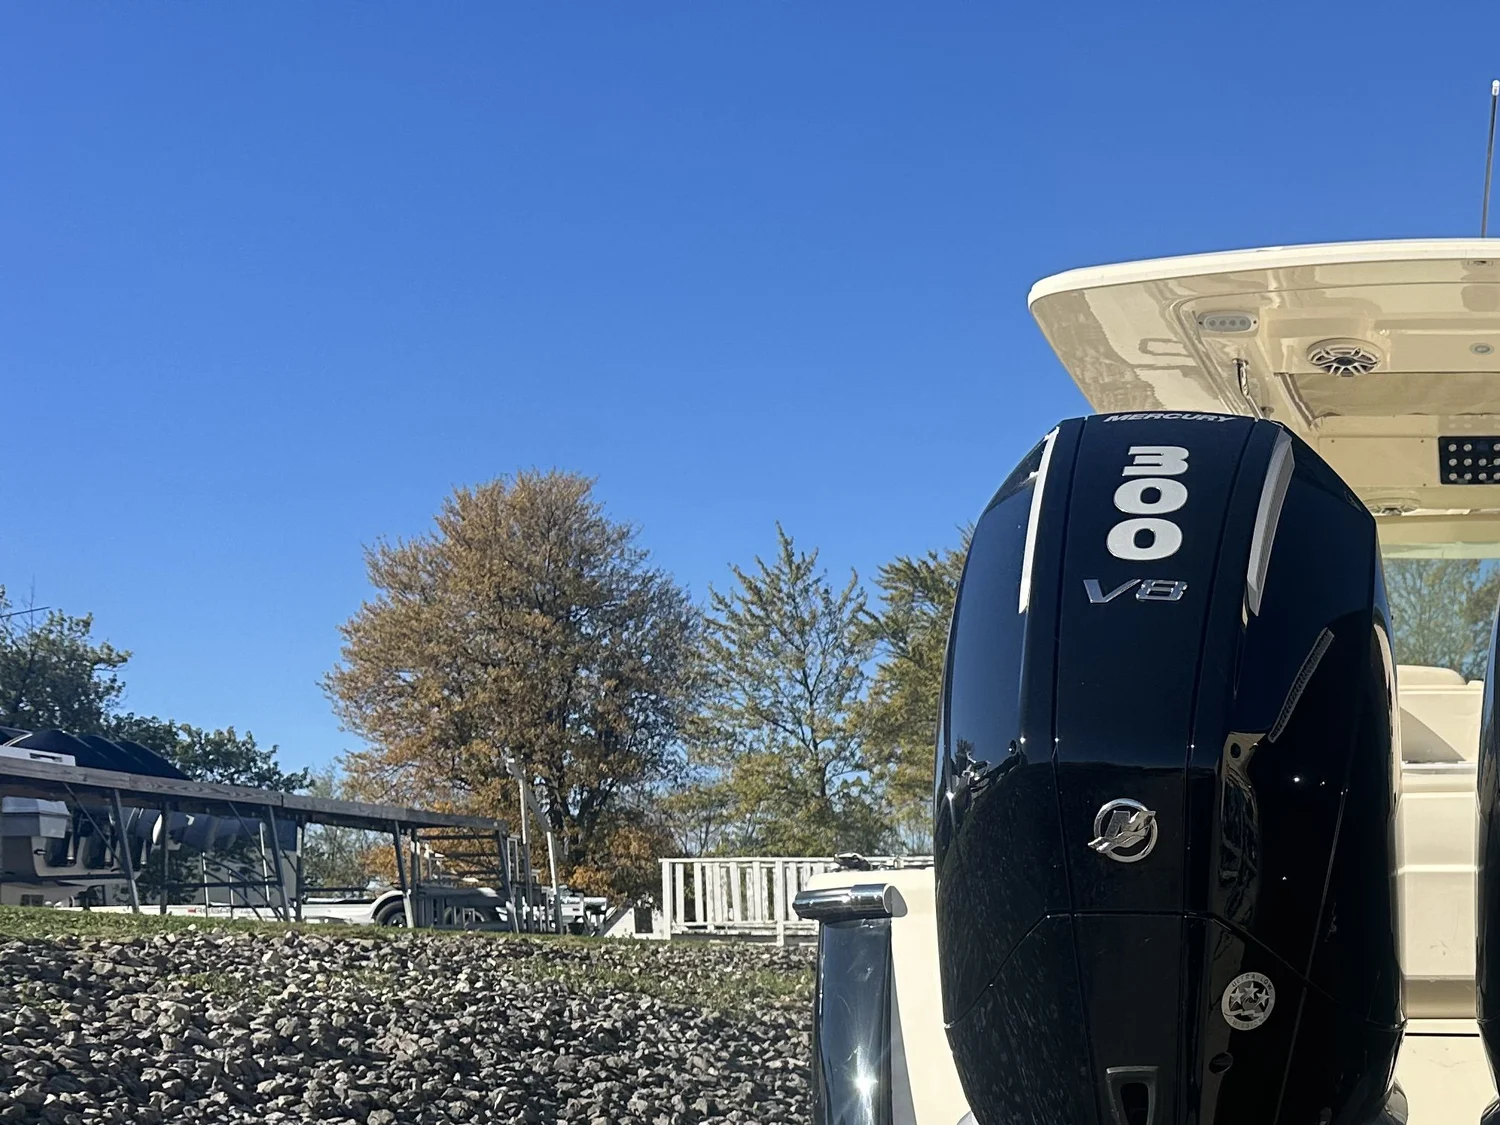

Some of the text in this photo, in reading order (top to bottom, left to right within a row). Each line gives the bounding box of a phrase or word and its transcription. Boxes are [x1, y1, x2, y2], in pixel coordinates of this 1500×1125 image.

[1103, 413, 1237, 422] MERCURY
[1106, 445, 1189, 561] 300
[1083, 579, 1188, 603] V8
